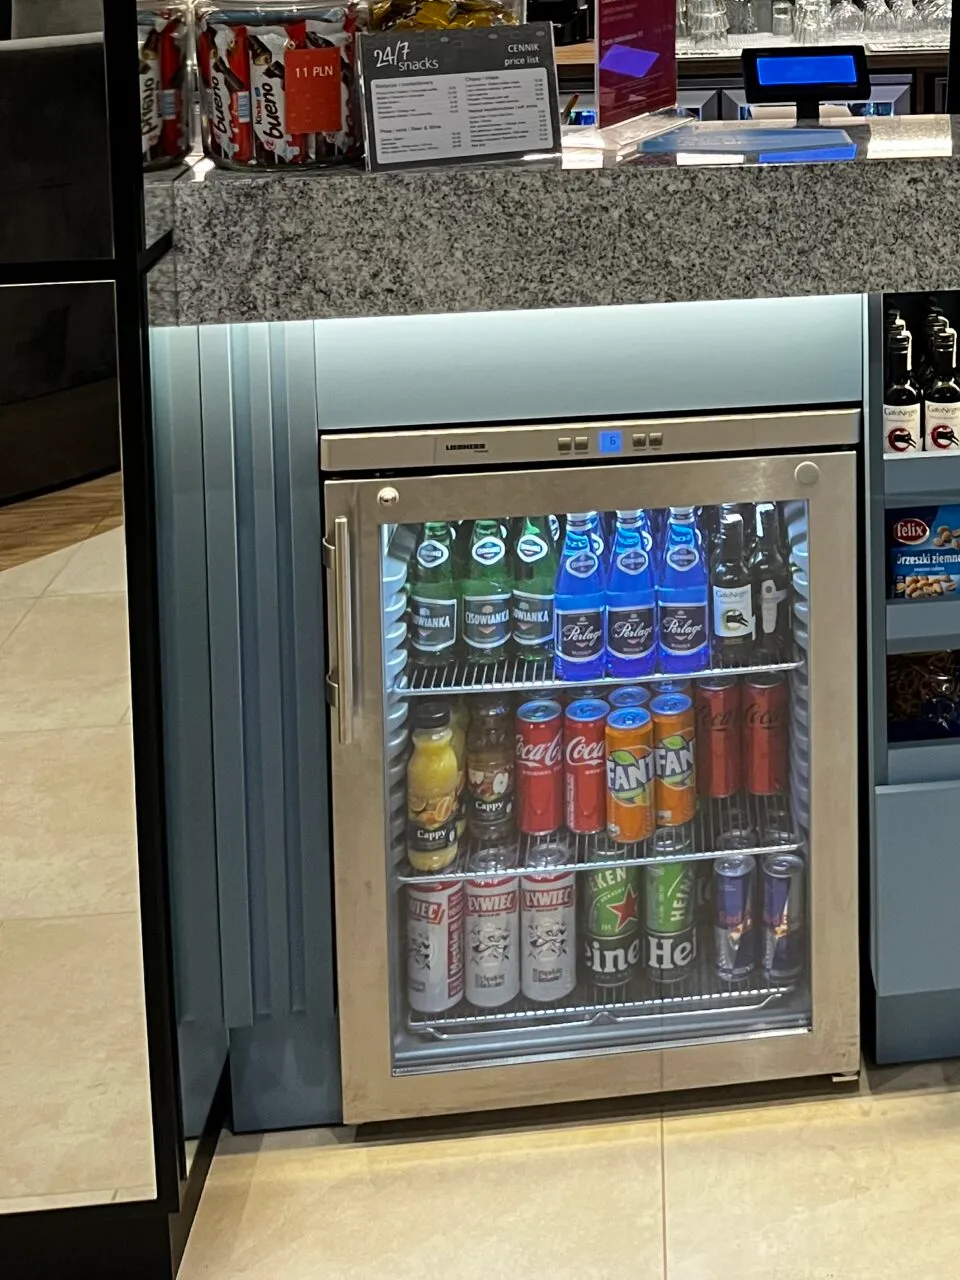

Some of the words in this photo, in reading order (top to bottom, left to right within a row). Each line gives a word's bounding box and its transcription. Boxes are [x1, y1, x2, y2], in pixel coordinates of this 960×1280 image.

[373, 40, 411, 68] 24/7
[507, 43, 540, 53] CENNIK
[398, 58, 440, 72] snacks
[504, 57, 525, 67] price
[526, 55, 540, 65] list
[294, 66, 308, 78] 11
[313, 66, 334, 78] PLN
[212, 76, 228, 135] bueno
[263, 82, 284, 140] bueno
[897, 521, 924, 537] felix
[465, 609, 510, 625] CISOWIANKA
[475, 801, 504, 812] Cappy
[417, 828, 447, 842] Cappy
